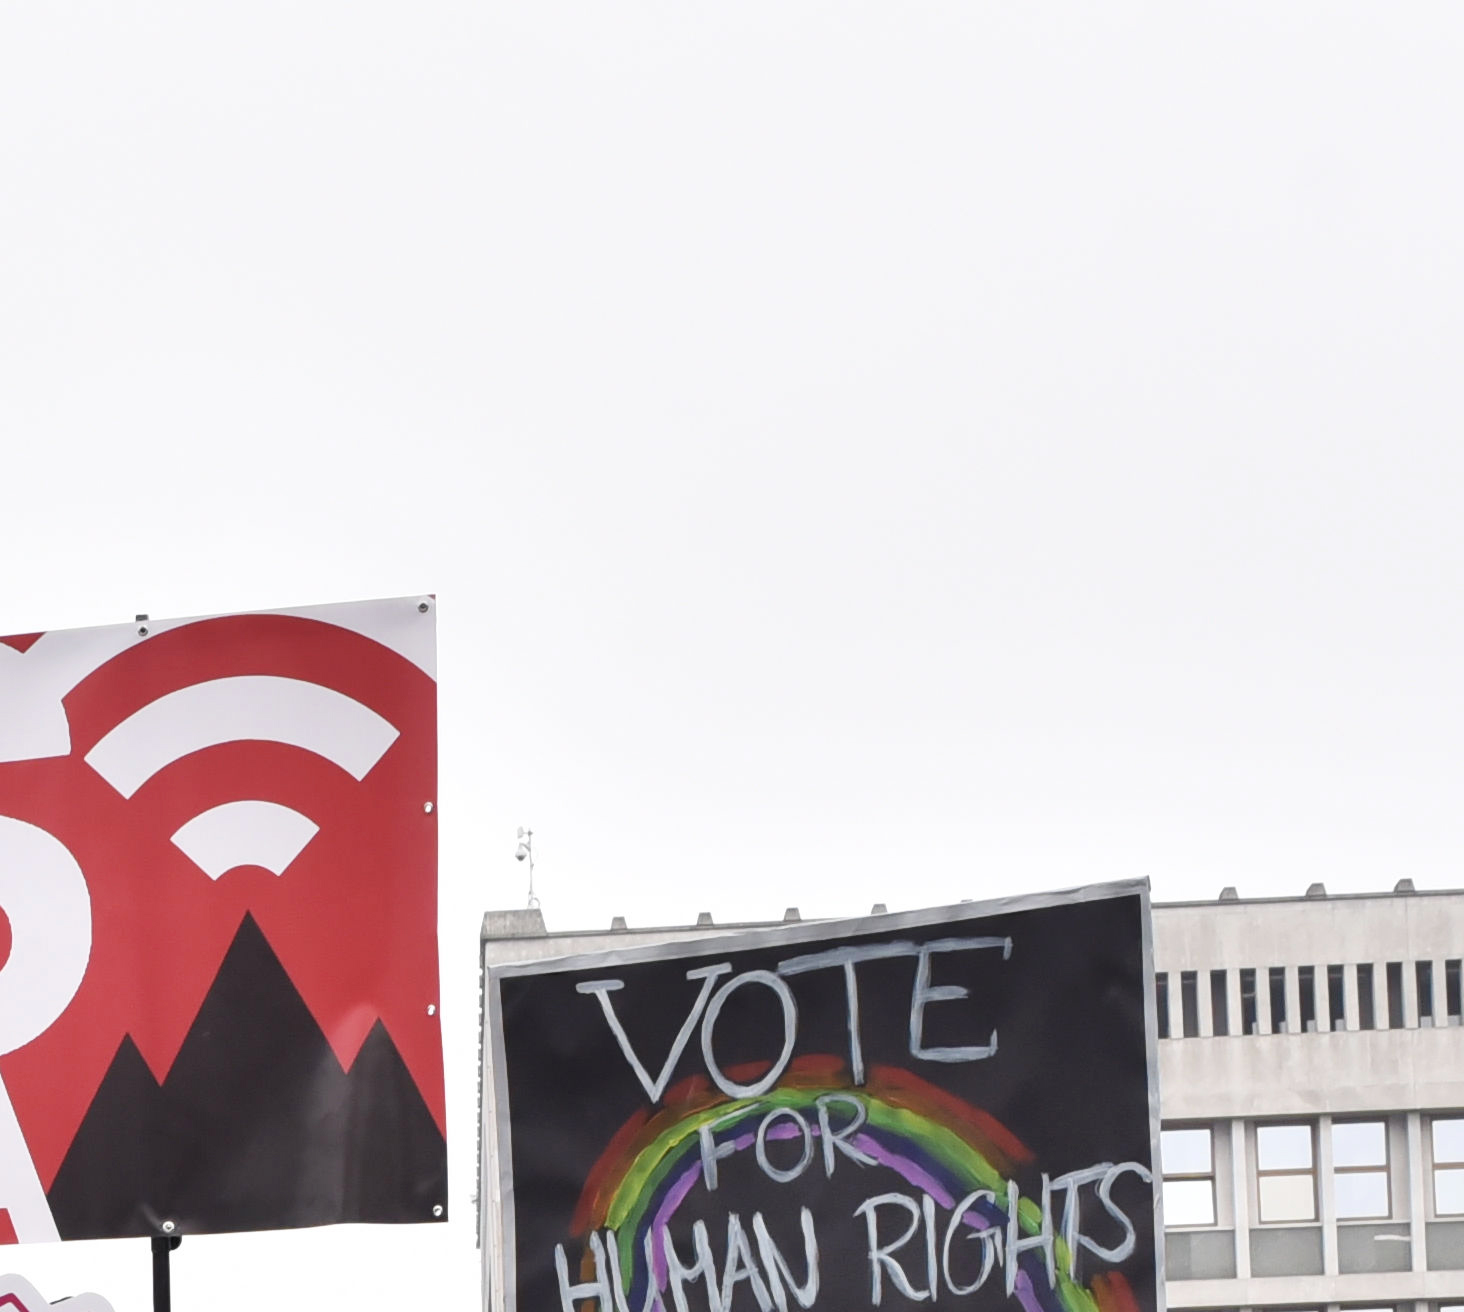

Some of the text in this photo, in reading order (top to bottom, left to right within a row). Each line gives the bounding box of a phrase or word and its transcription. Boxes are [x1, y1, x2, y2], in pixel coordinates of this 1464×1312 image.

[576, 936, 1012, 1103] VOTE
[700, 1093, 878, 1190] FOR
[854, 1160, 1152, 1306] RIGHTS
